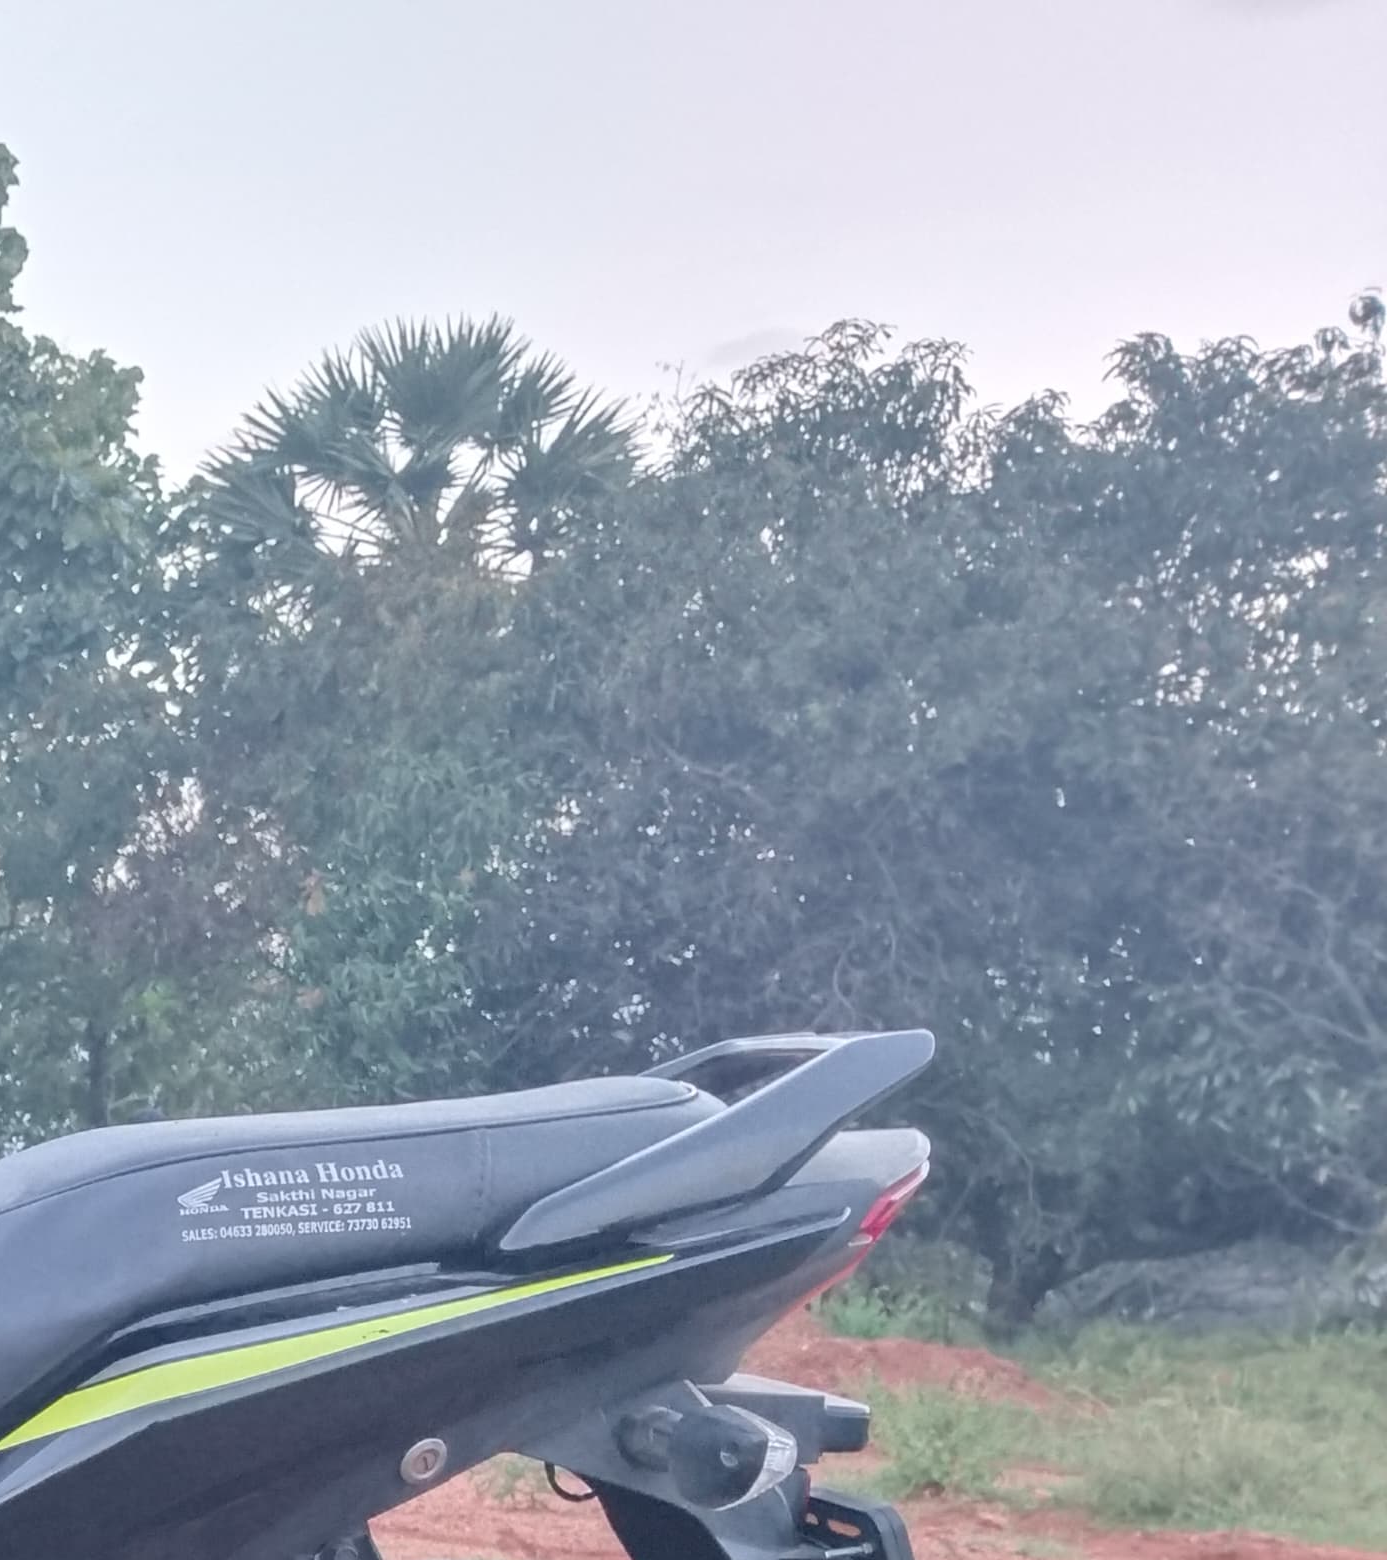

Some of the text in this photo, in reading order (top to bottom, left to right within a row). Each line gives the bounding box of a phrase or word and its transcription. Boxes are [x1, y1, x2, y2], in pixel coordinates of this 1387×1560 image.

[221, 1160, 404, 1189] Ishana Honda
[256, 1188, 377, 1203] Sakthi Nagar
[179, 1204, 230, 1216] HONDA
[240, 1203, 318, 1220] TENKASI
[333, 1202, 362, 1215] 627
[366, 1200, 395, 1213] 811
[181, 1227, 218, 1242] SALES:
[220, 1225, 252, 1239] 04633
[298, 1220, 345, 1235] SERVICE:
[347, 1218, 378, 1232] 73730
[381, 1216, 412, 1230] 62951
